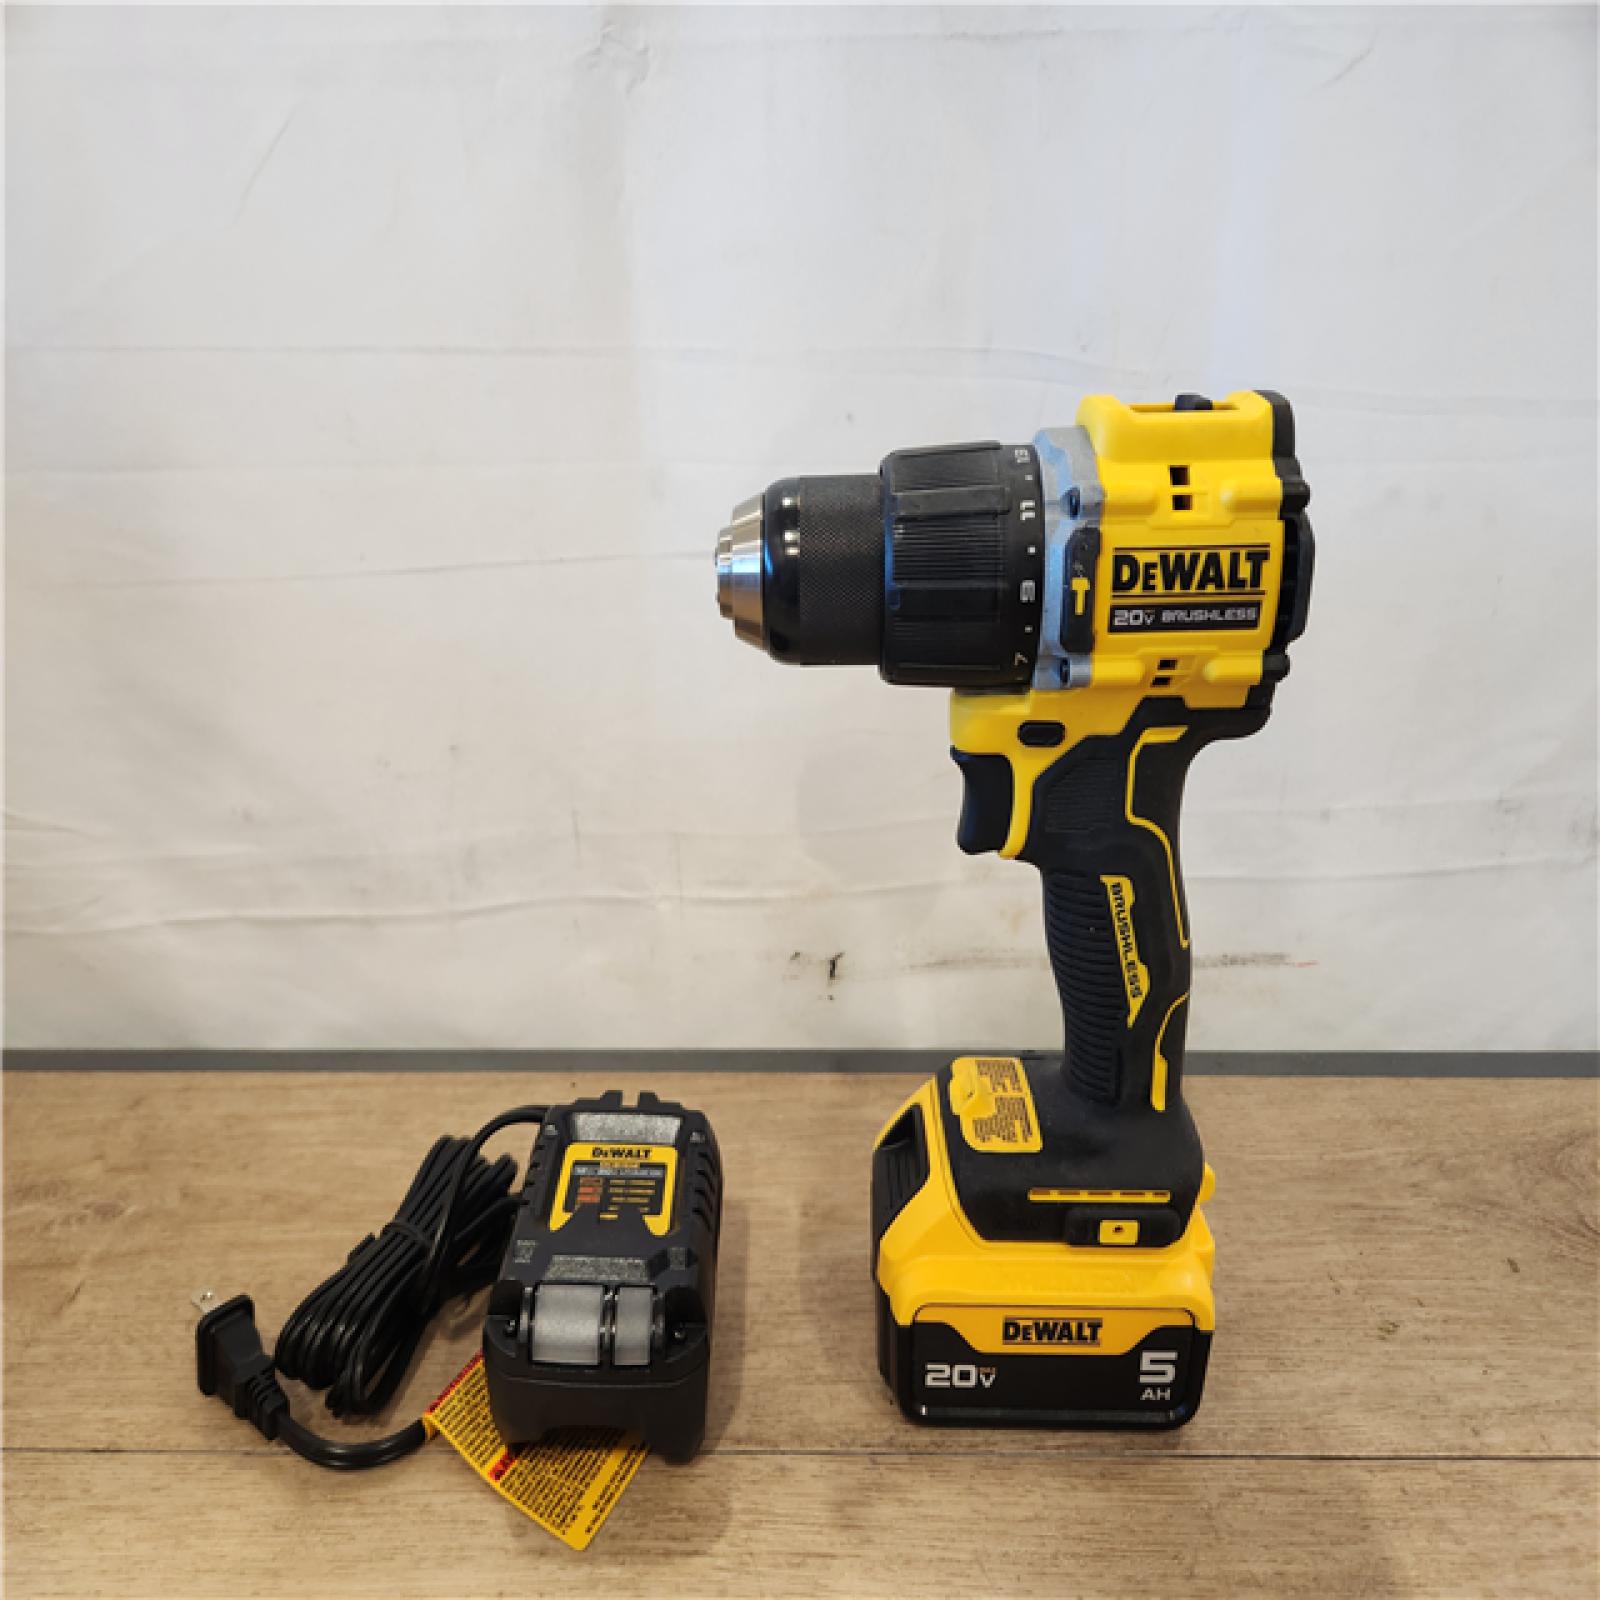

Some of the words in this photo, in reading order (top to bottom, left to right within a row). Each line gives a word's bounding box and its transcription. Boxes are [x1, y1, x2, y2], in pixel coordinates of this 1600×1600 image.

[1019, 500, 1036, 521] 11
[1161, 606, 1257, 622] BRUSHLESS
[1138, 1351, 1179, 1384] 5
[1140, 1387, 1171, 1401] AH
